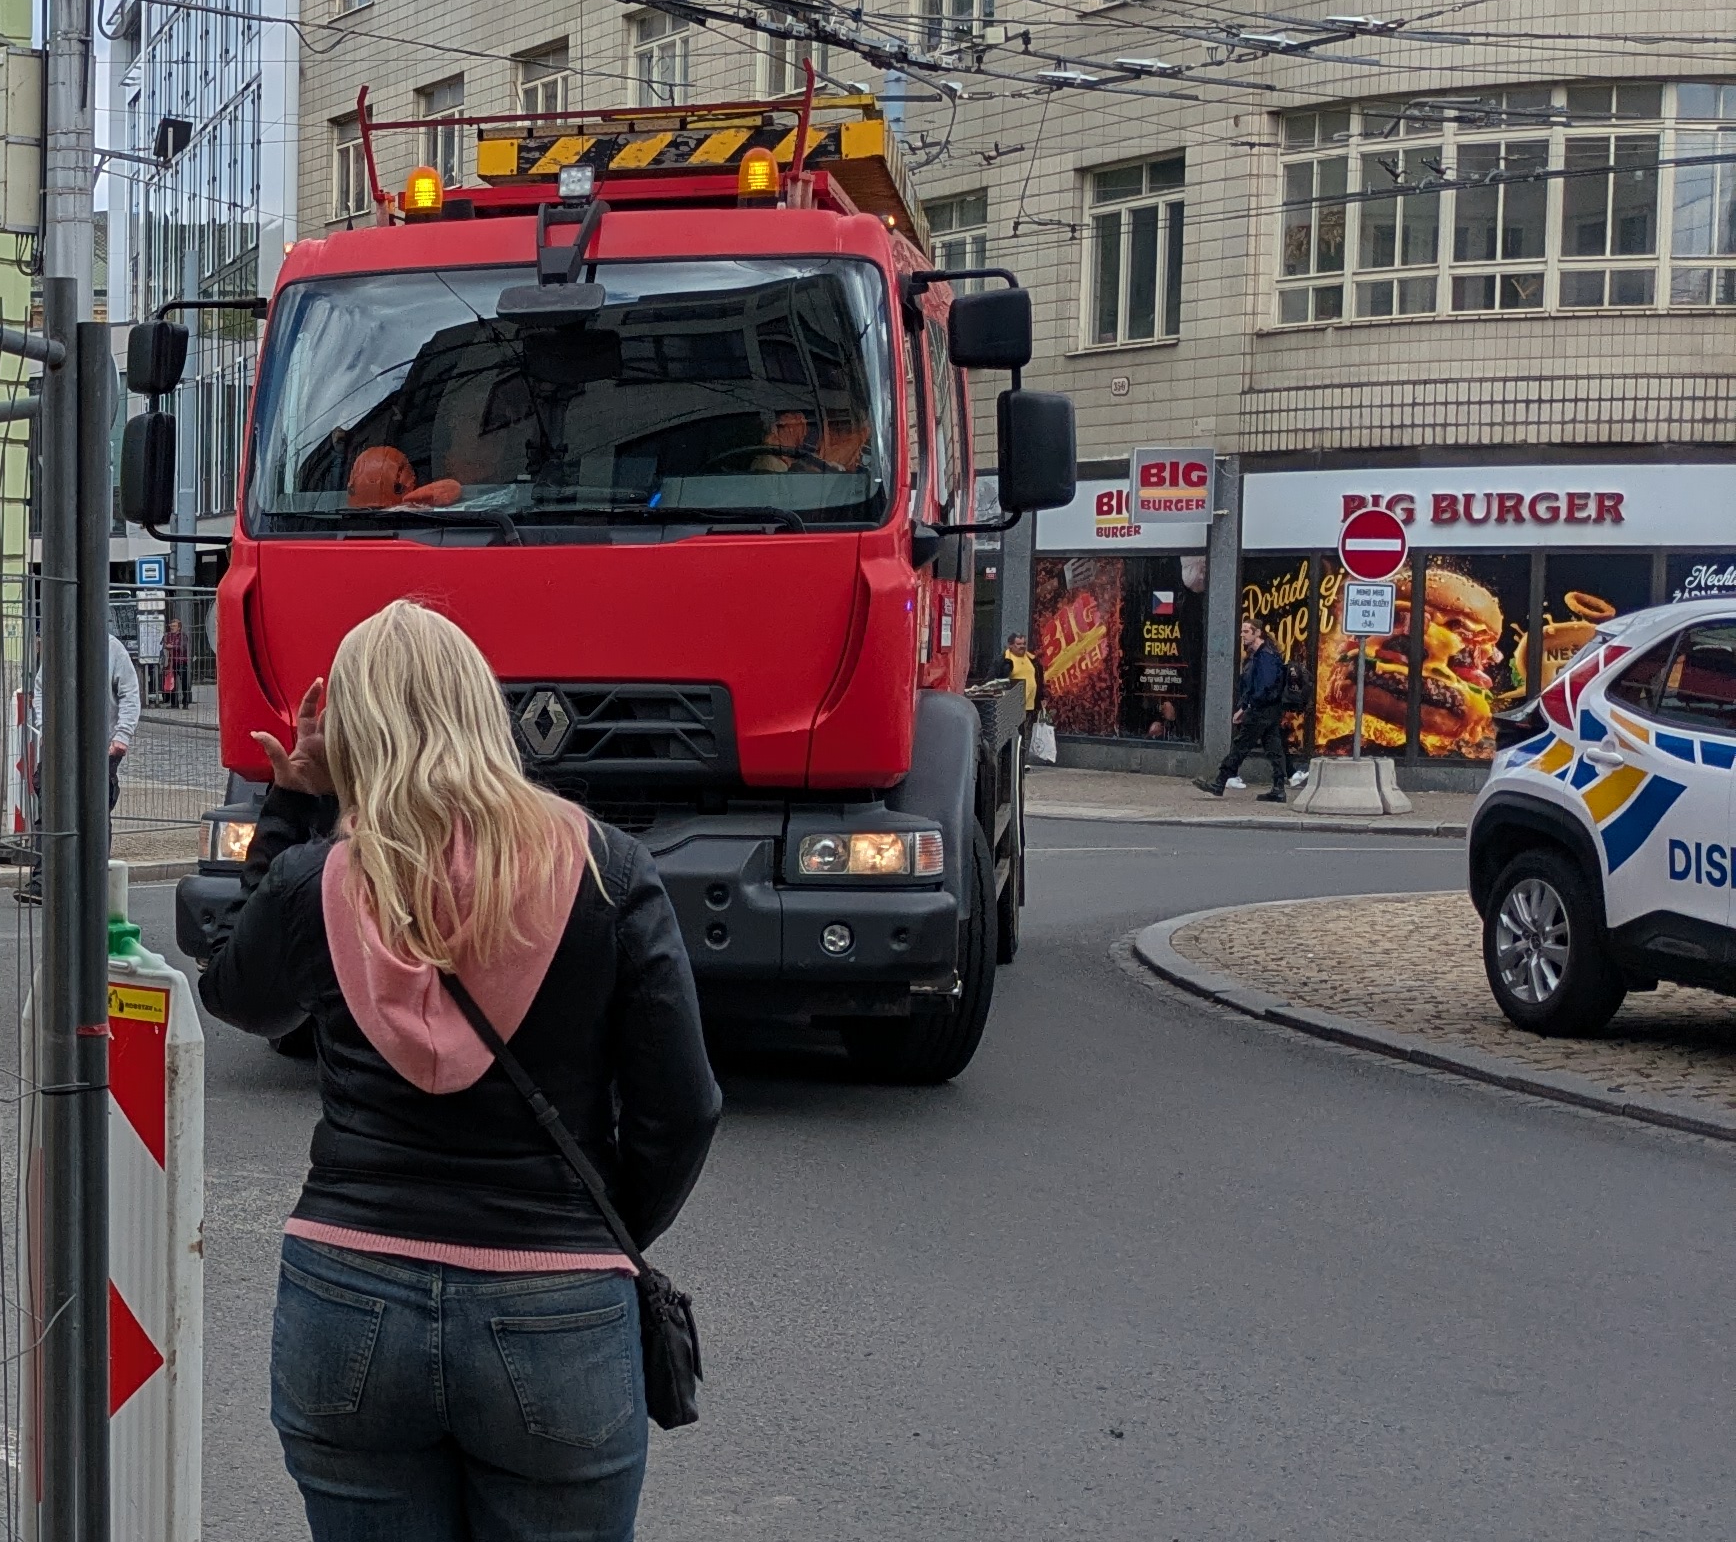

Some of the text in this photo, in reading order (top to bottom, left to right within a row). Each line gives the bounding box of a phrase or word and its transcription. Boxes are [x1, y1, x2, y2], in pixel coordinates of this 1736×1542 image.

[1140, 461, 1208, 488] BIG
[1096, 490, 1130, 516] BI
[1140, 499, 1206, 512] BURGER
[1430, 492, 1625, 524] BURGER
[1096, 524, 1142, 538] BURGER
[1043, 593, 1101, 669] BIG
[1143, 621, 1181, 639] ČESKÁ
[1145, 642, 1179, 656] FIRMA
[1669, 839, 1736, 889] DIS
